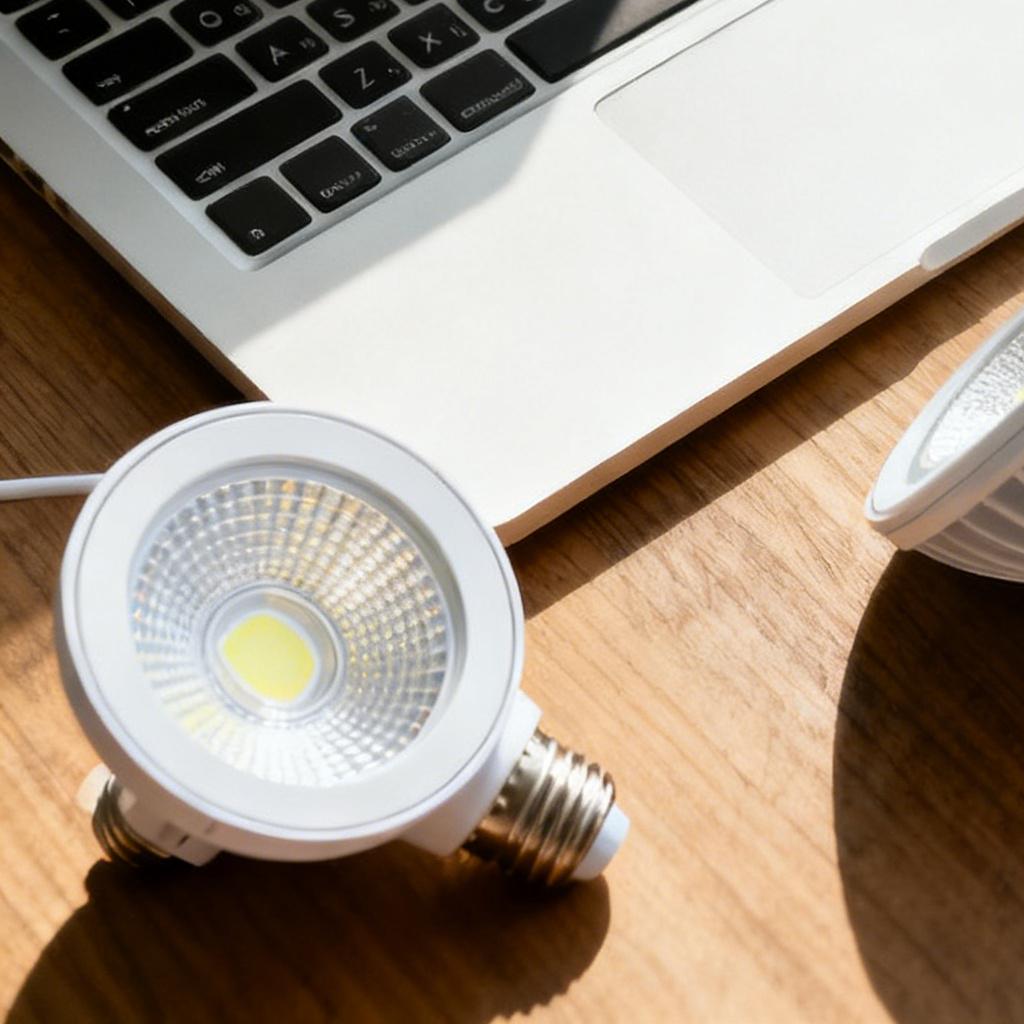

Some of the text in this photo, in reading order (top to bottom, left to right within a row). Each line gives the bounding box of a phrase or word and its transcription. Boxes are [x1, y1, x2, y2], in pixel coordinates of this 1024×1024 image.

[332, 8, 356, 28] S
[417, 31, 443, 54] X
[268, 44, 290, 66] A
[352, 67, 376, 91] Z
